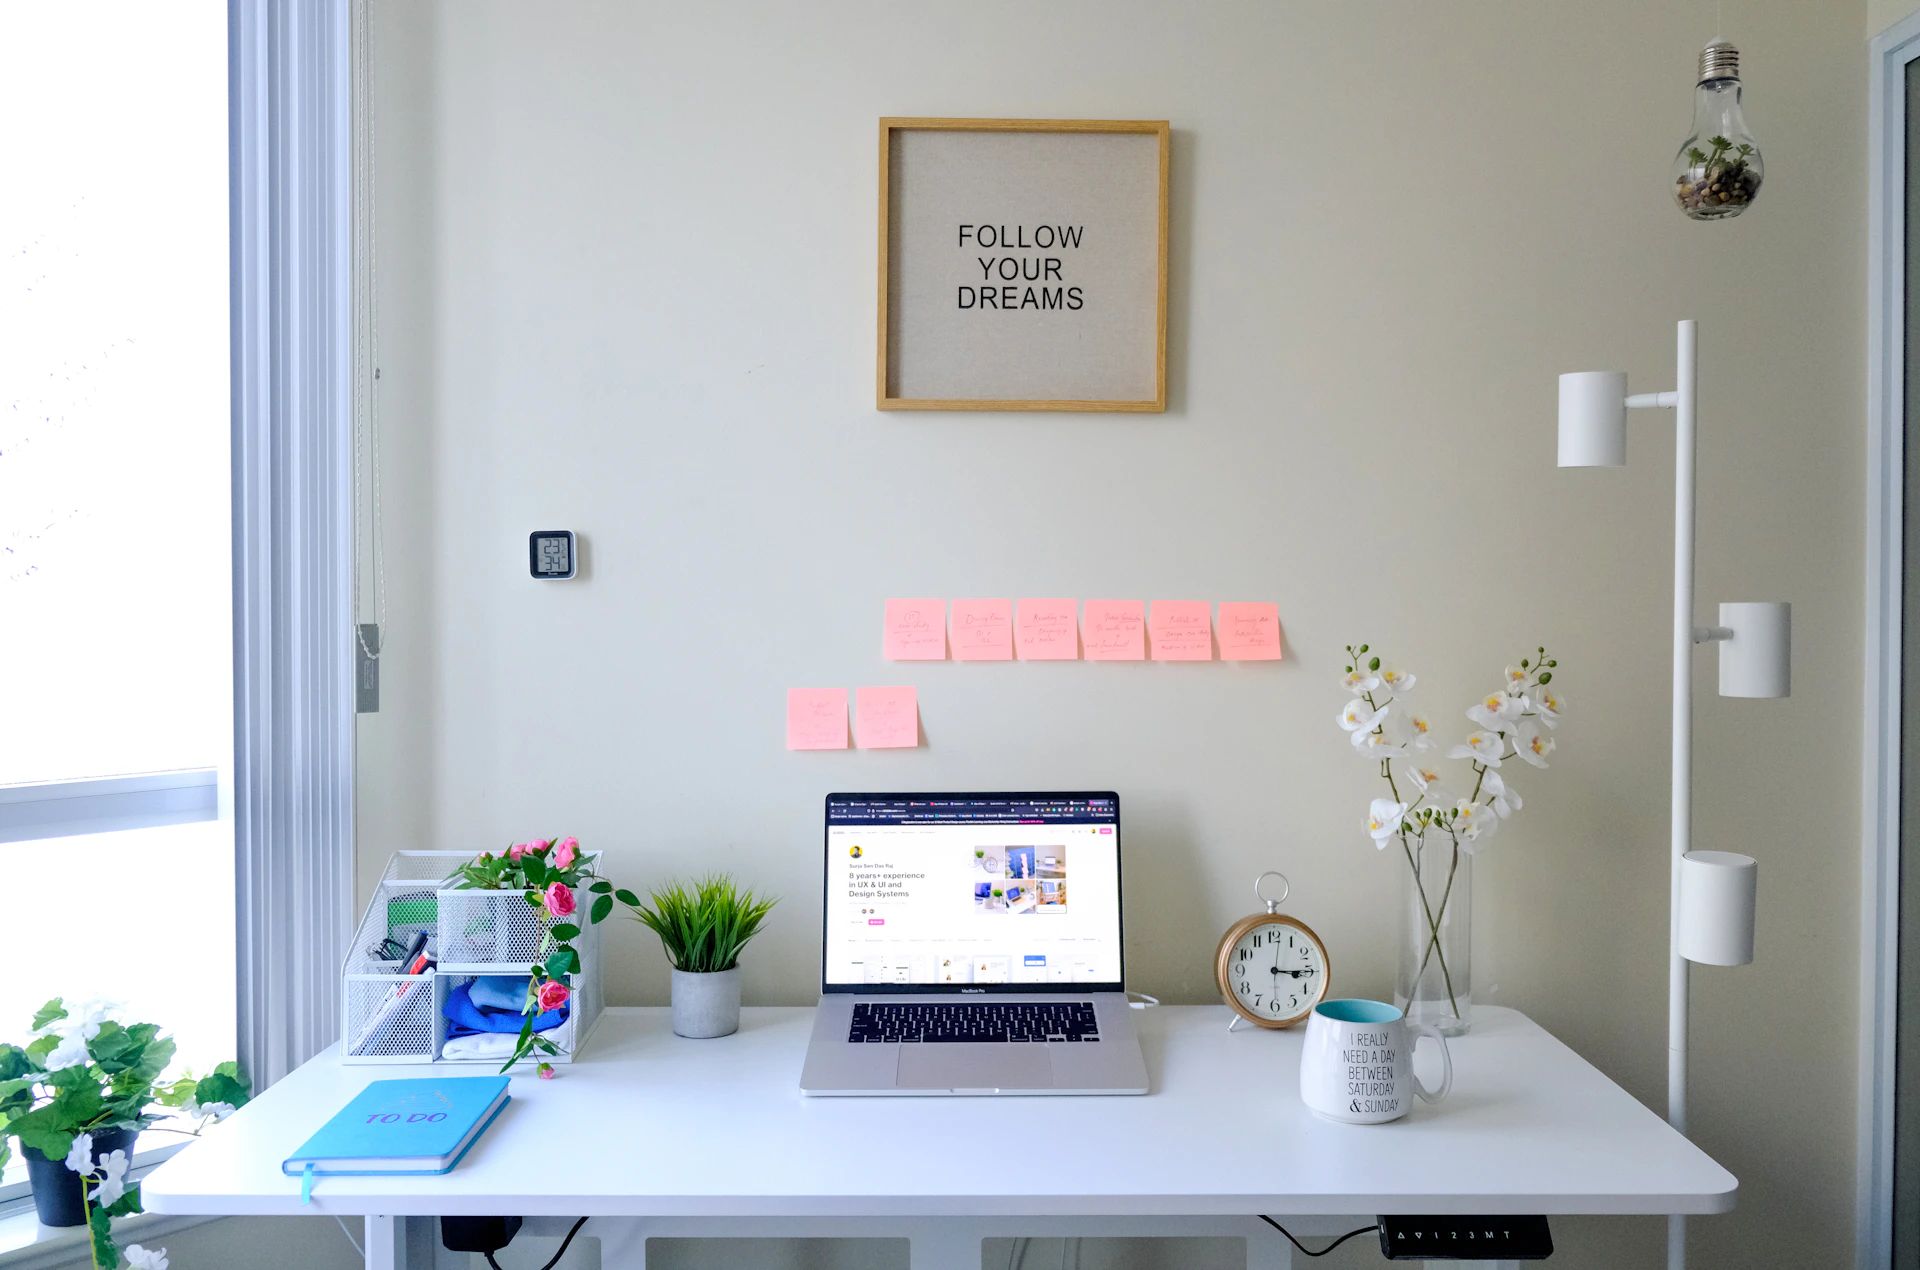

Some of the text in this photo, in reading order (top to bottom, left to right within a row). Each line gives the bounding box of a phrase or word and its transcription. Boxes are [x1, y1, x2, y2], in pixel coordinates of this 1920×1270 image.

[958, 224, 1084, 249] FOLLOW
[977, 257, 1063, 281] YOUR
[958, 286, 1084, 310] DREAMS
[544, 538, 560, 554] 23
[544, 555, 561, 571] 34
[883, 872, 925, 880] experience
[848, 890, 909, 899] Design Systems
[1253, 934, 1261, 948] 11
[1268, 930, 1281, 943] 12
[1289, 935, 1293, 948] 1
[1240, 948, 1253, 961] 10
[1299, 947, 1309, 960] 2
[1235, 963, 1246, 977] 9
[1240, 981, 1250, 995] 8
[1299, 982, 1309, 995] 4
[1254, 994, 1263, 1006] 7
[1270, 999, 1280, 1013] 6
[1287, 994, 1297, 1008] 5
[1350, 1032, 1389, 1046] I REALLY
[1343, 1049, 1396, 1063] NEED A DAY
[1348, 1066, 1393, 1080] BETWEEN
[1348, 1082, 1395, 1096] SATURDAY
[1349, 1098, 1399, 1113] & SUNDAY
[365, 1112, 448, 1124] TO DO
[1451, 1231, 1457, 1239] 2
[1469, 1231, 1475, 1239] 3
[1485, 1231, 1494, 1239] M
[1503, 1231, 1510, 1239] T
